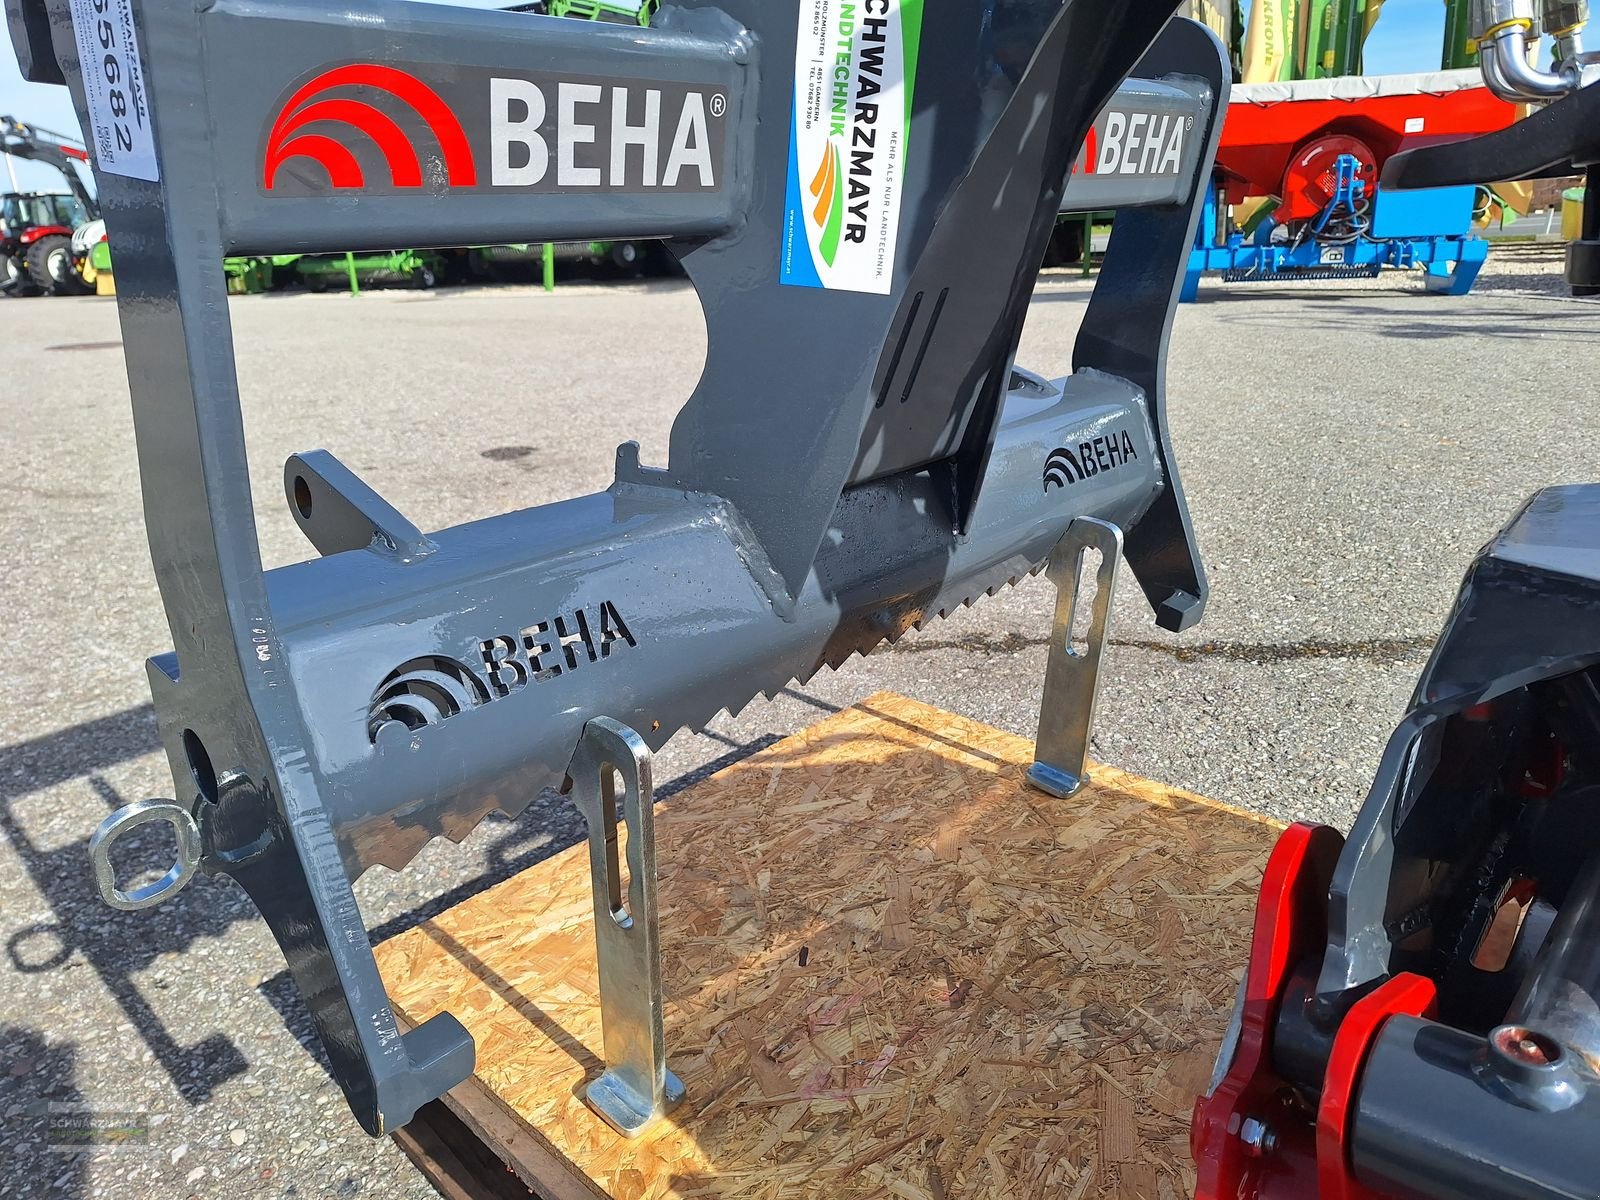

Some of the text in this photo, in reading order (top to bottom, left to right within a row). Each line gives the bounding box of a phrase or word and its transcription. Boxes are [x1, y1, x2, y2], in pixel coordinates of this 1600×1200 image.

[829, 0, 857, 137] NDTECHNIK
[813, 86, 822, 122] GAMPERN
[889, 131, 898, 160] MEHR
[886, 163, 894, 182] ALS
[883, 186, 892, 206] NUR
[1078, 429, 1138, 478] BEHA
[480, 600, 638, 700] BEHA
